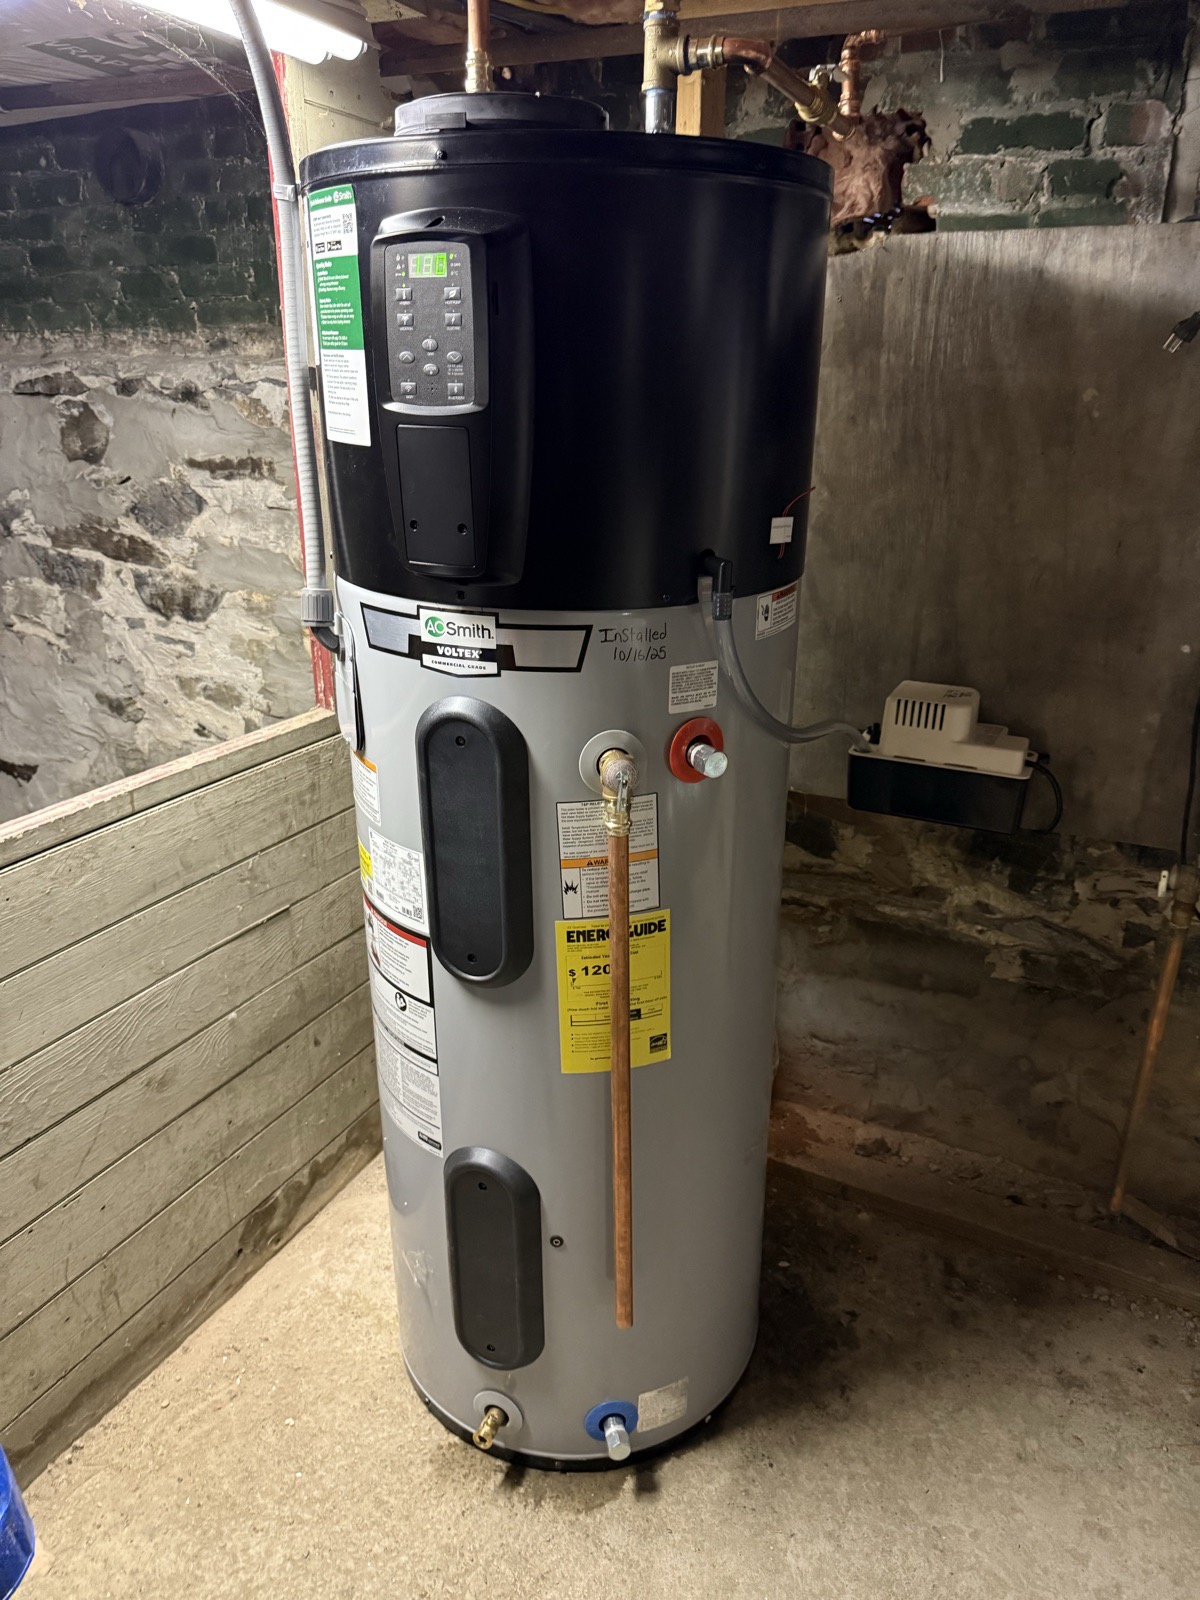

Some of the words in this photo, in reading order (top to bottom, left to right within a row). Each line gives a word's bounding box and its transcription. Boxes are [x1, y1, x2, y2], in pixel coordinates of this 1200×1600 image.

[599, 622, 667, 643] Installed
[436, 645, 480, 659] VOLTEX
[613, 646, 667, 662] 10/16/25
[431, 659, 466, 668] COMMERCIAL
